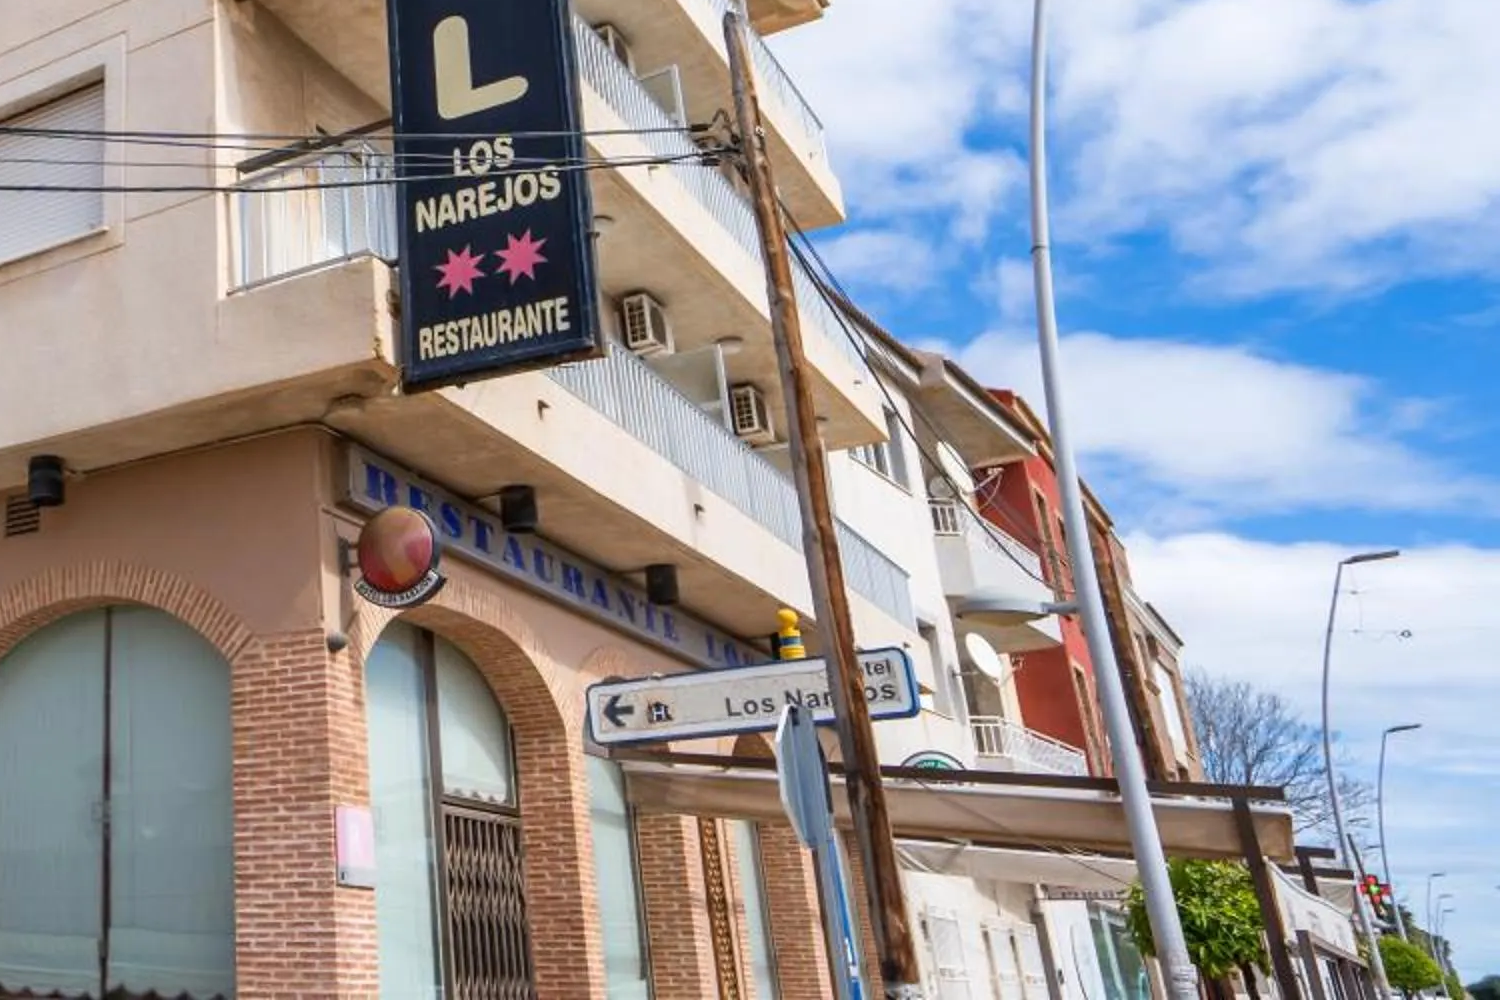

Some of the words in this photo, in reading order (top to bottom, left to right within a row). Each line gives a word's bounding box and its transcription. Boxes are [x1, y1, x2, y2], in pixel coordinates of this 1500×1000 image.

[453, 136, 516, 178] LOS
[416, 165, 561, 233] NAREJOS
[419, 297, 570, 361] RESTAURANTE
[862, 658, 892, 676] tel
[725, 697, 776, 717] Los
[784, 683, 897, 710] Naros
